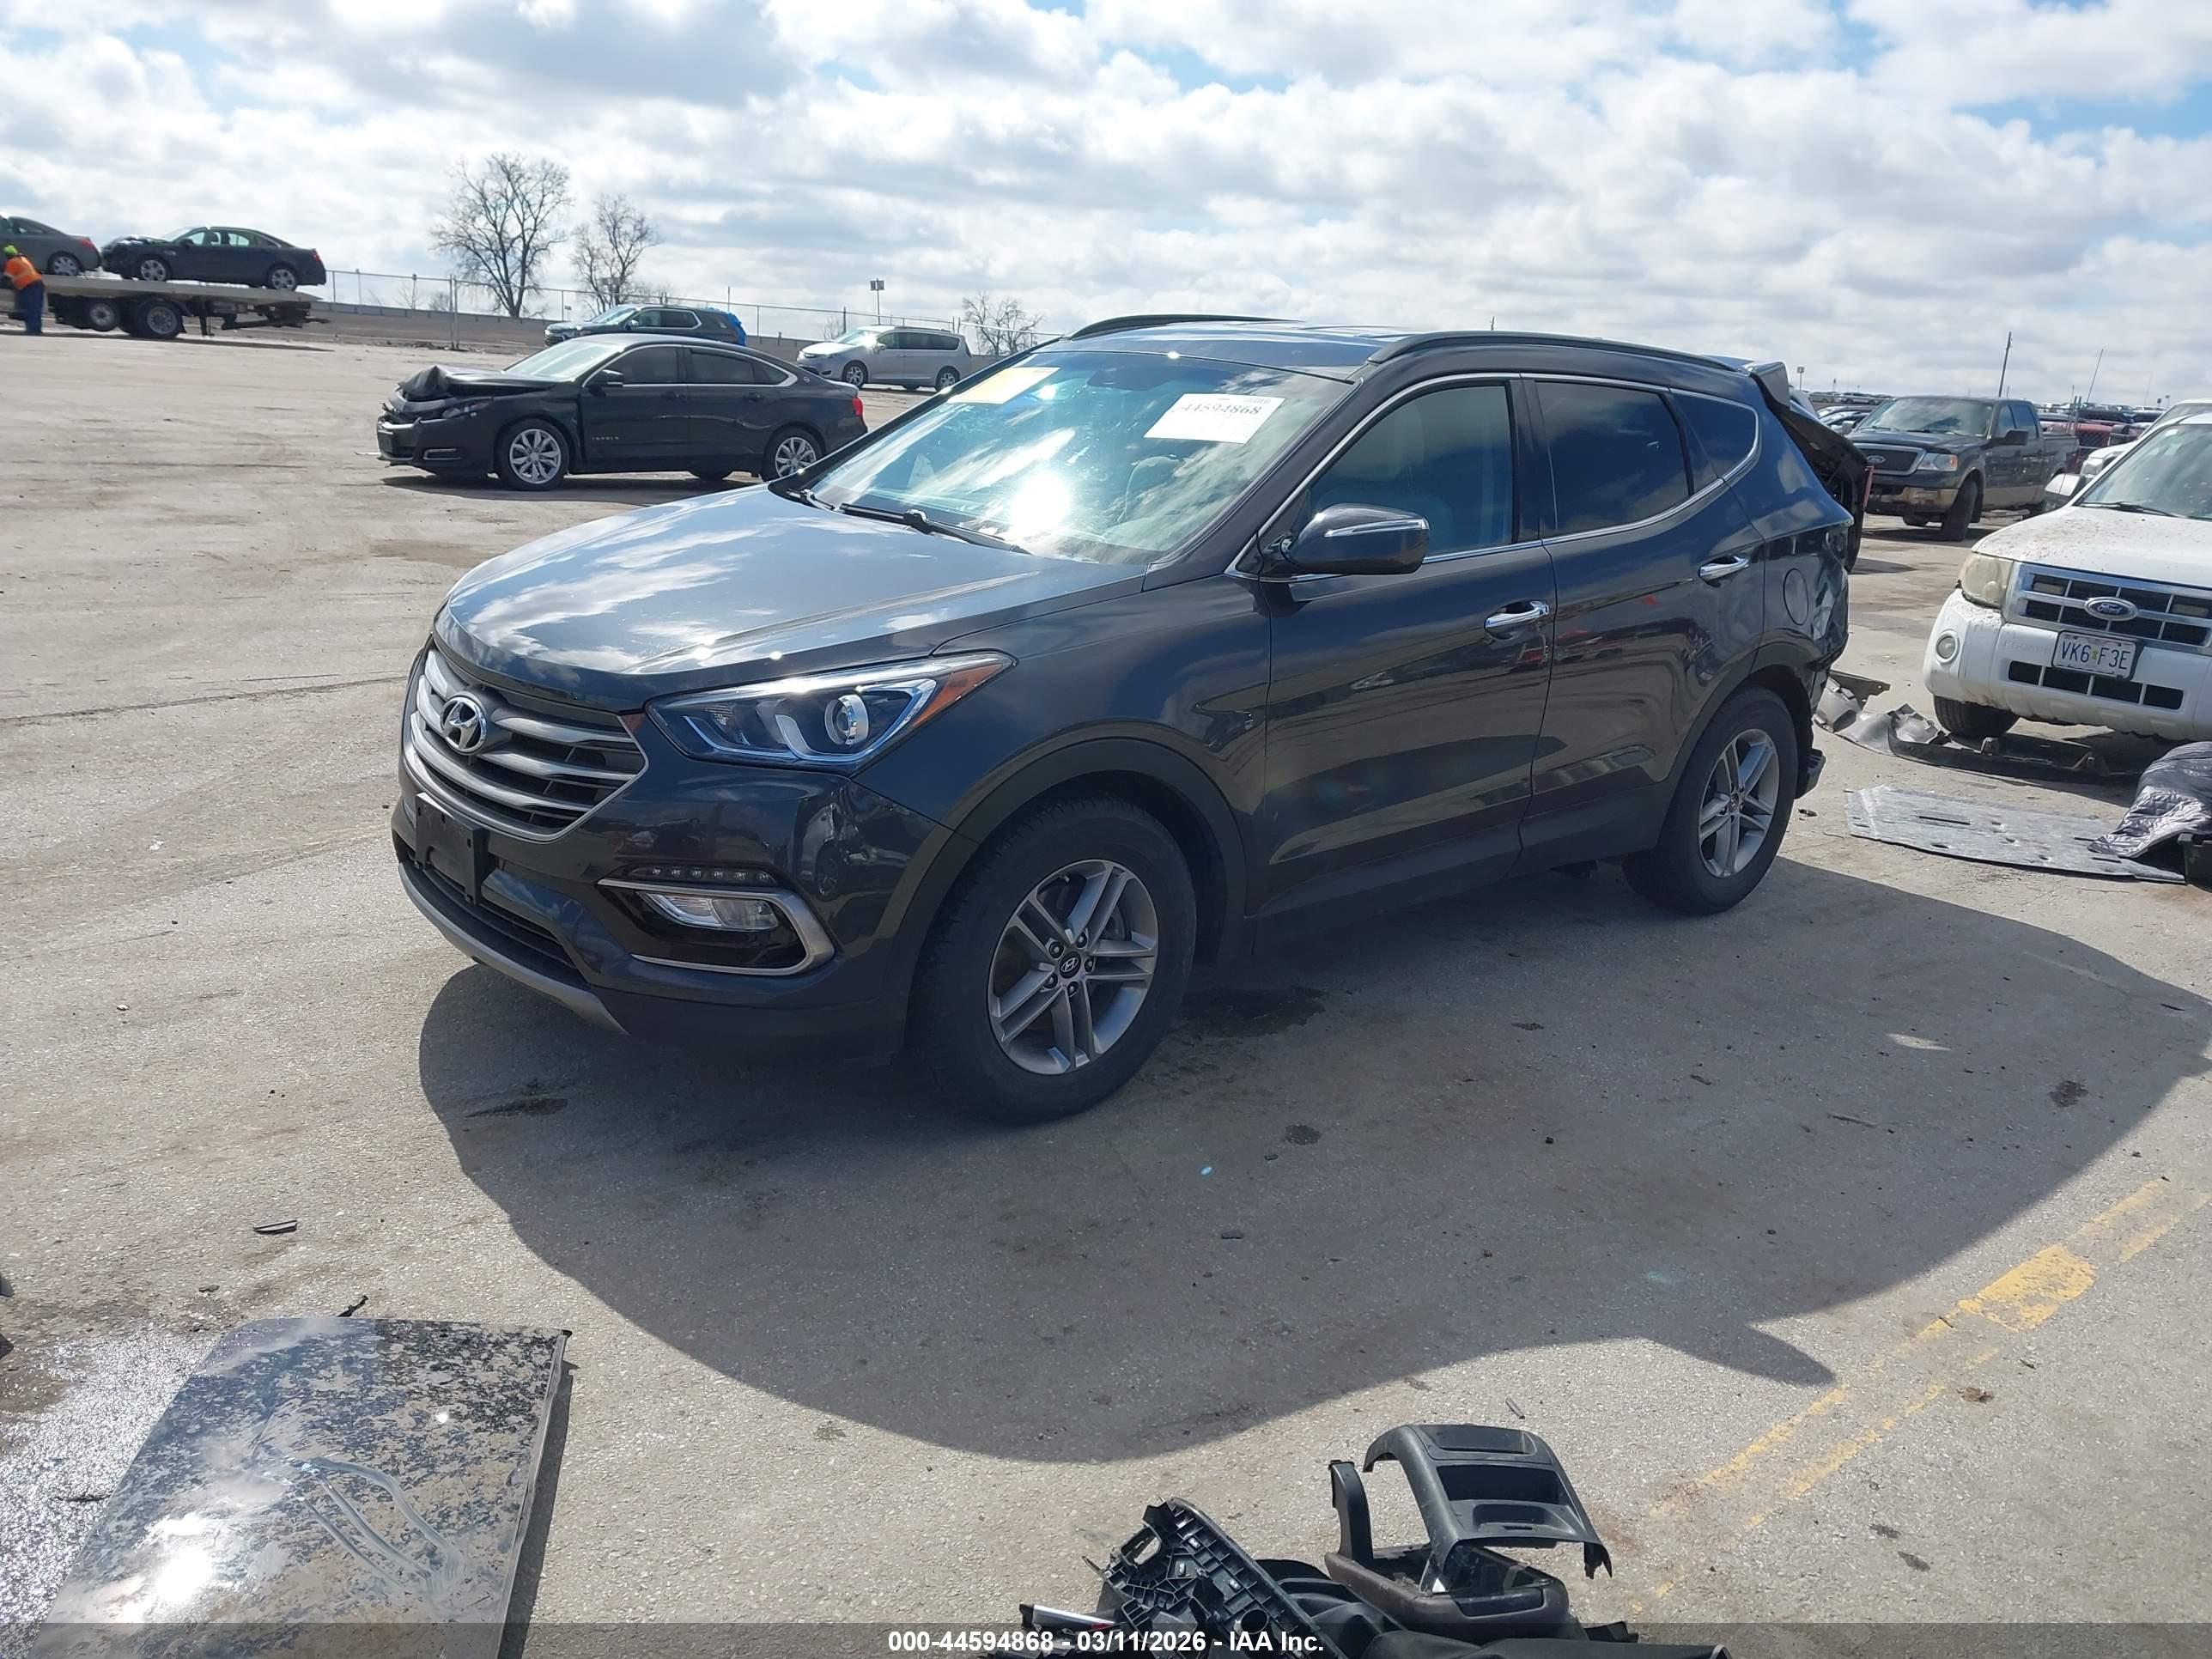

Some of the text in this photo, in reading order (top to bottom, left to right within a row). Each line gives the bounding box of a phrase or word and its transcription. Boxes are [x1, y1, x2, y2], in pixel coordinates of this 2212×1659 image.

[2097, 604, 2123, 614] Ford
[2062, 641, 2091, 663] VK6
[2097, 647, 2130, 670] F3E
